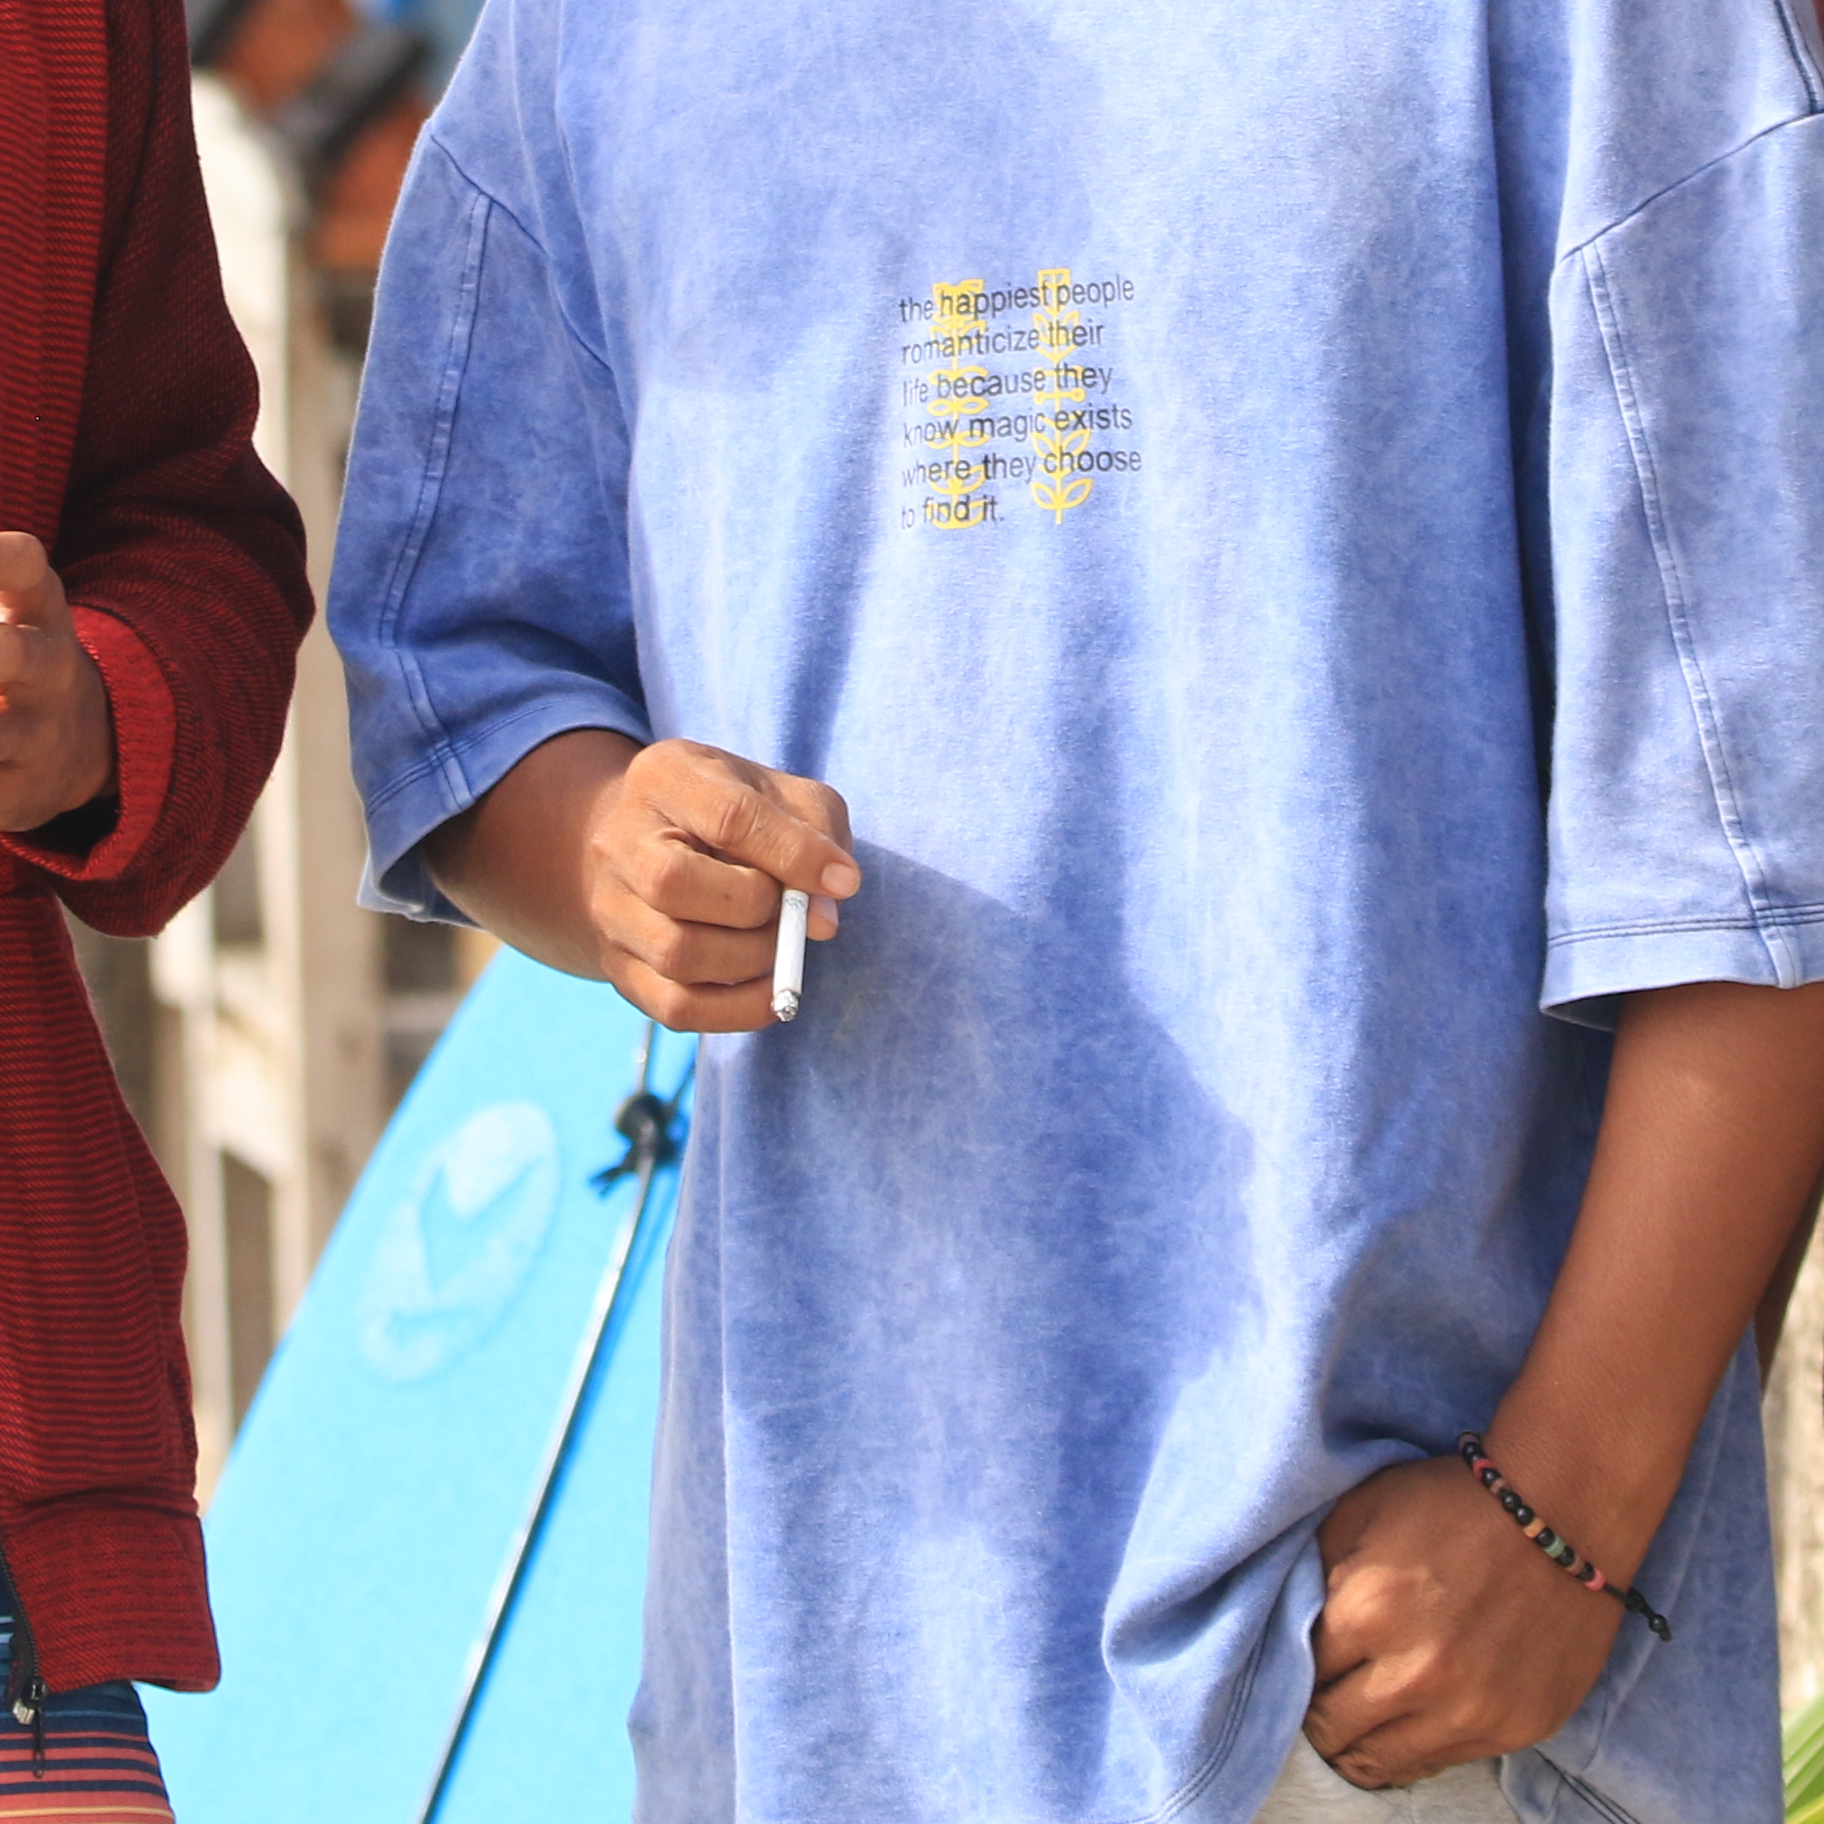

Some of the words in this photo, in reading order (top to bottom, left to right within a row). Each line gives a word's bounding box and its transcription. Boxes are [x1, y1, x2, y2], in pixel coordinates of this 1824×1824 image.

[899, 297, 934, 322] the
[937, 282, 1051, 319] happiest
[1056, 274, 1135, 312] people
[902, 324, 1040, 365] romanticize
[1048, 319, 1105, 348] their
[902, 379, 929, 407] life
[937, 366, 1047, 399] because
[1055, 363, 1113, 394] they
[902, 417, 959, 448] know
[969, 407, 1046, 442] magic
[1054, 403, 1133, 432] exists
[901, 458, 971, 488] where
[981, 453, 1037, 483] they
[1044, 446, 1142, 474] choose
[901, 504, 916, 530] to
[922, 495, 971, 522] find
[982, 495, 1005, 522] it.
